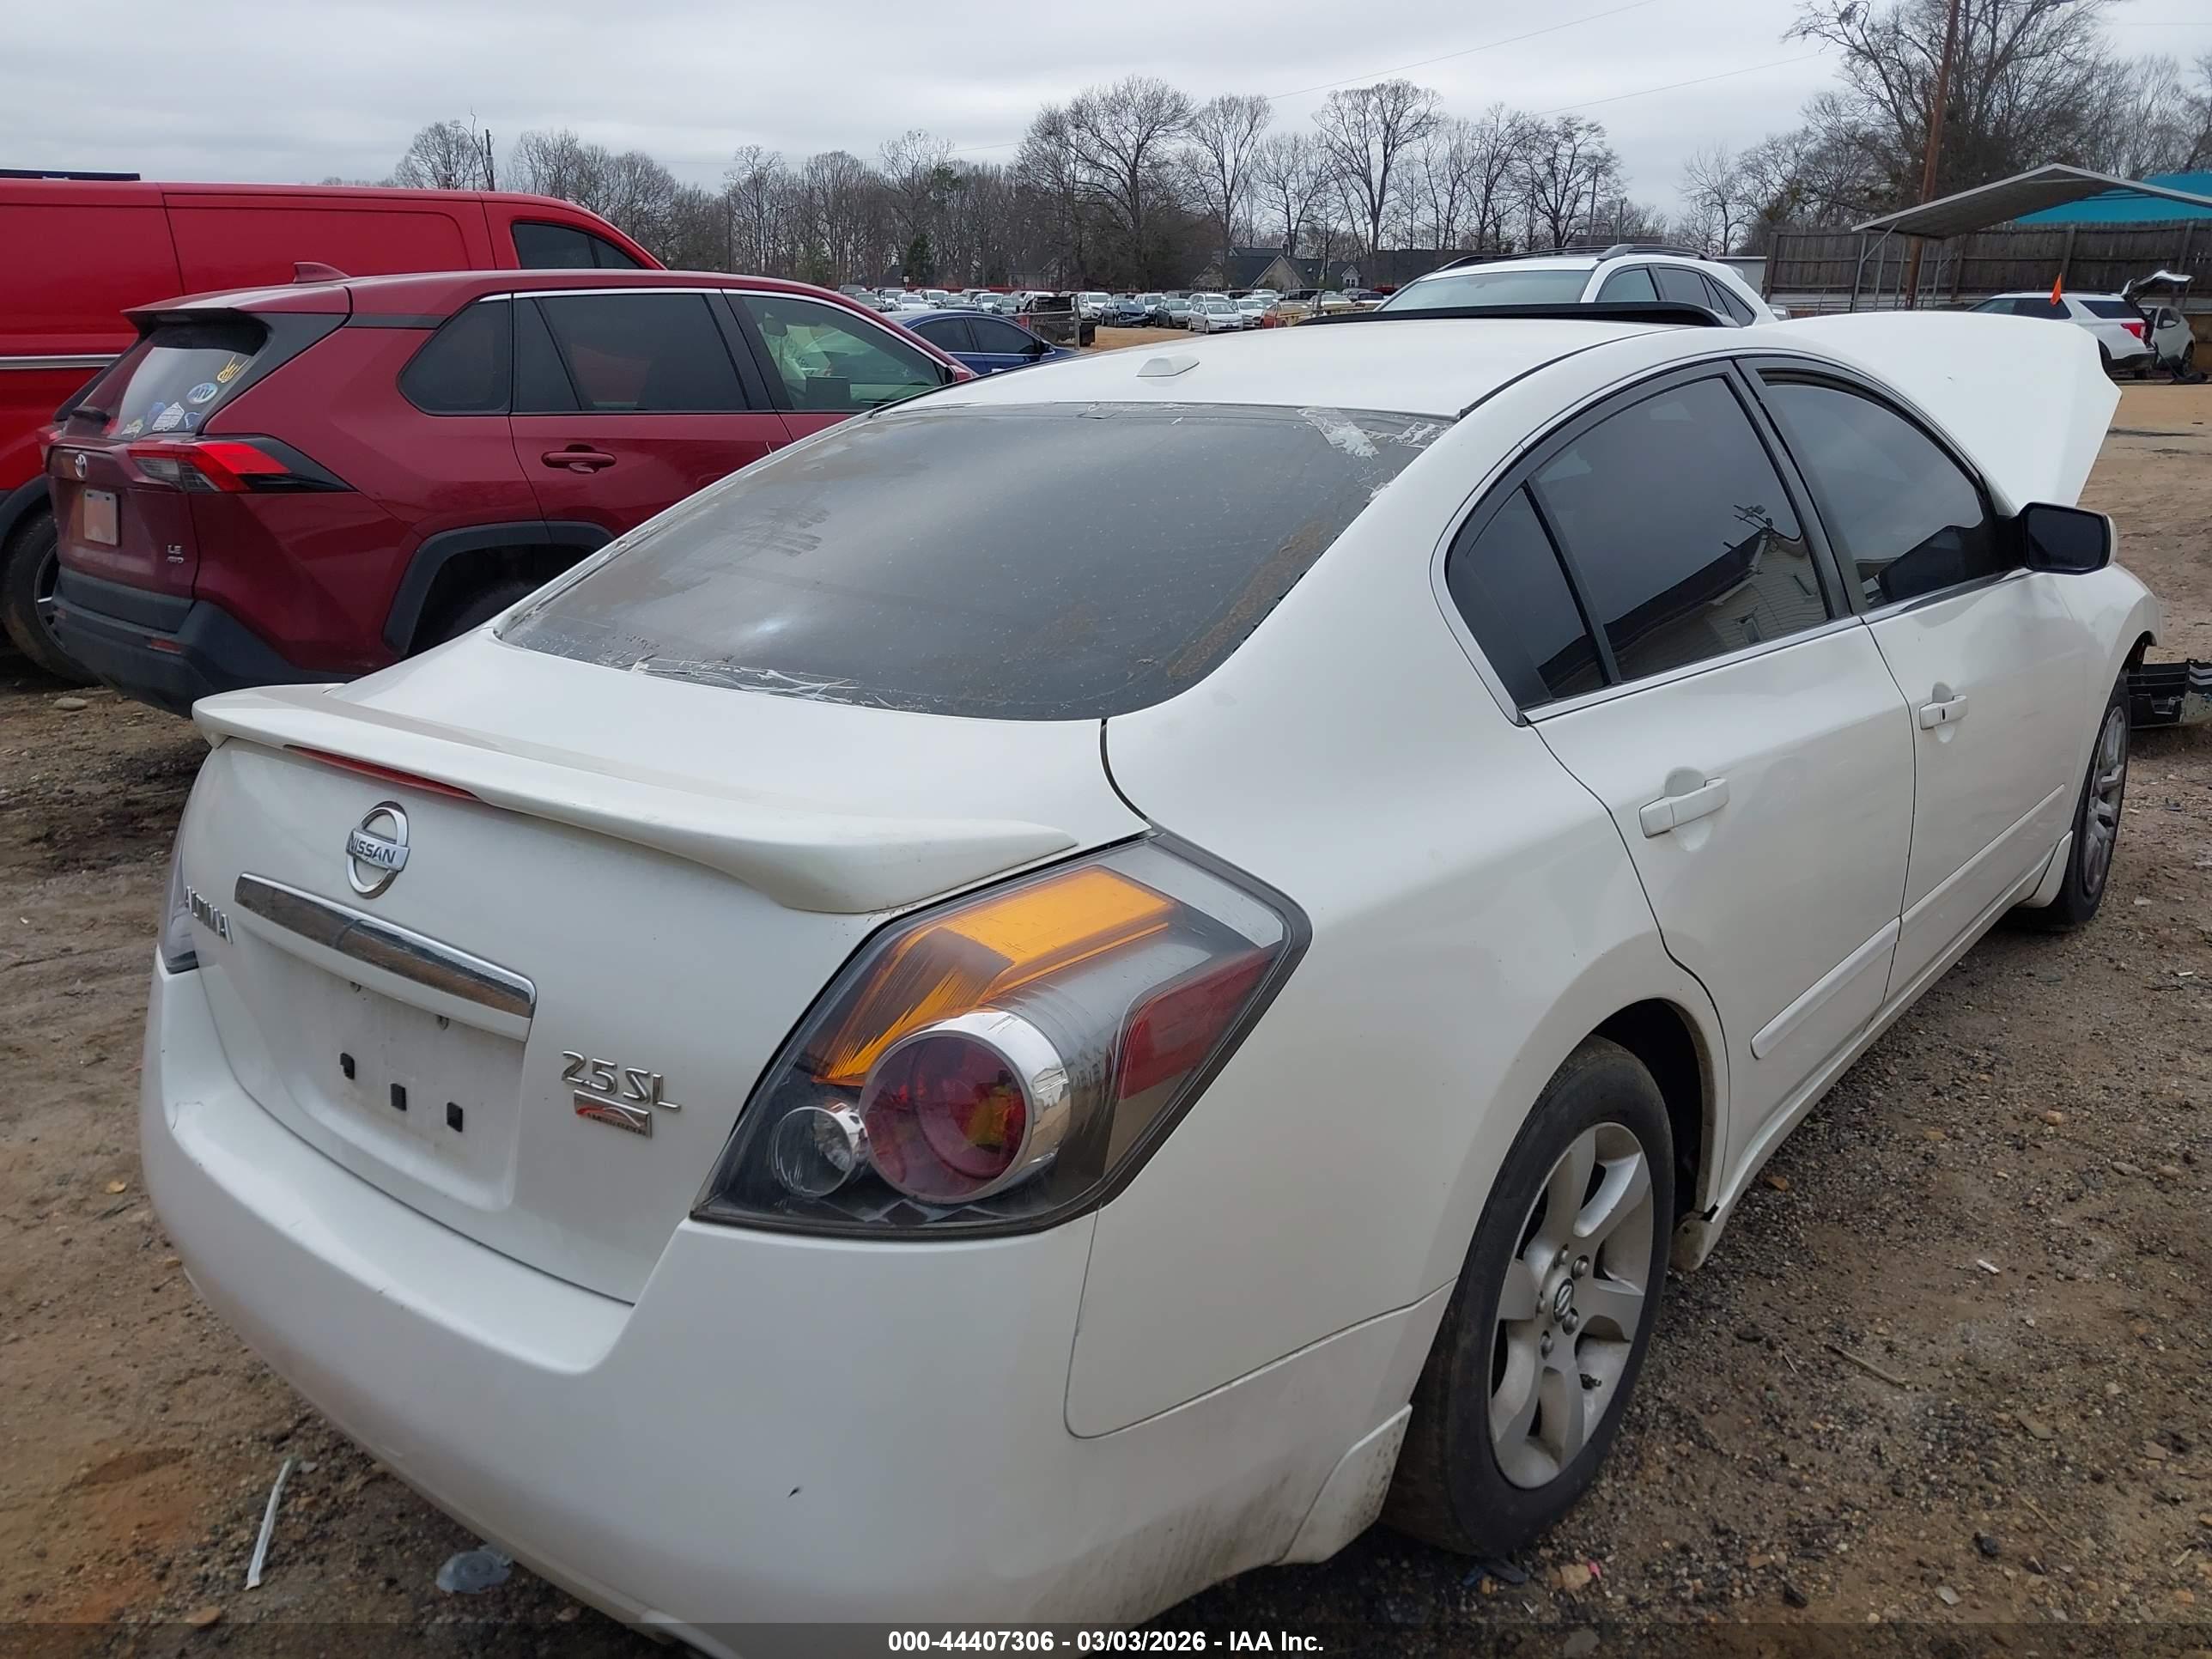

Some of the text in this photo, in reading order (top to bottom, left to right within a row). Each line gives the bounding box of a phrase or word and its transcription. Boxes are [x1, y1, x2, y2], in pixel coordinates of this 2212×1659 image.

[348, 836, 397, 864] NISSAN
[562, 1050, 681, 1111] 2.5 SL
